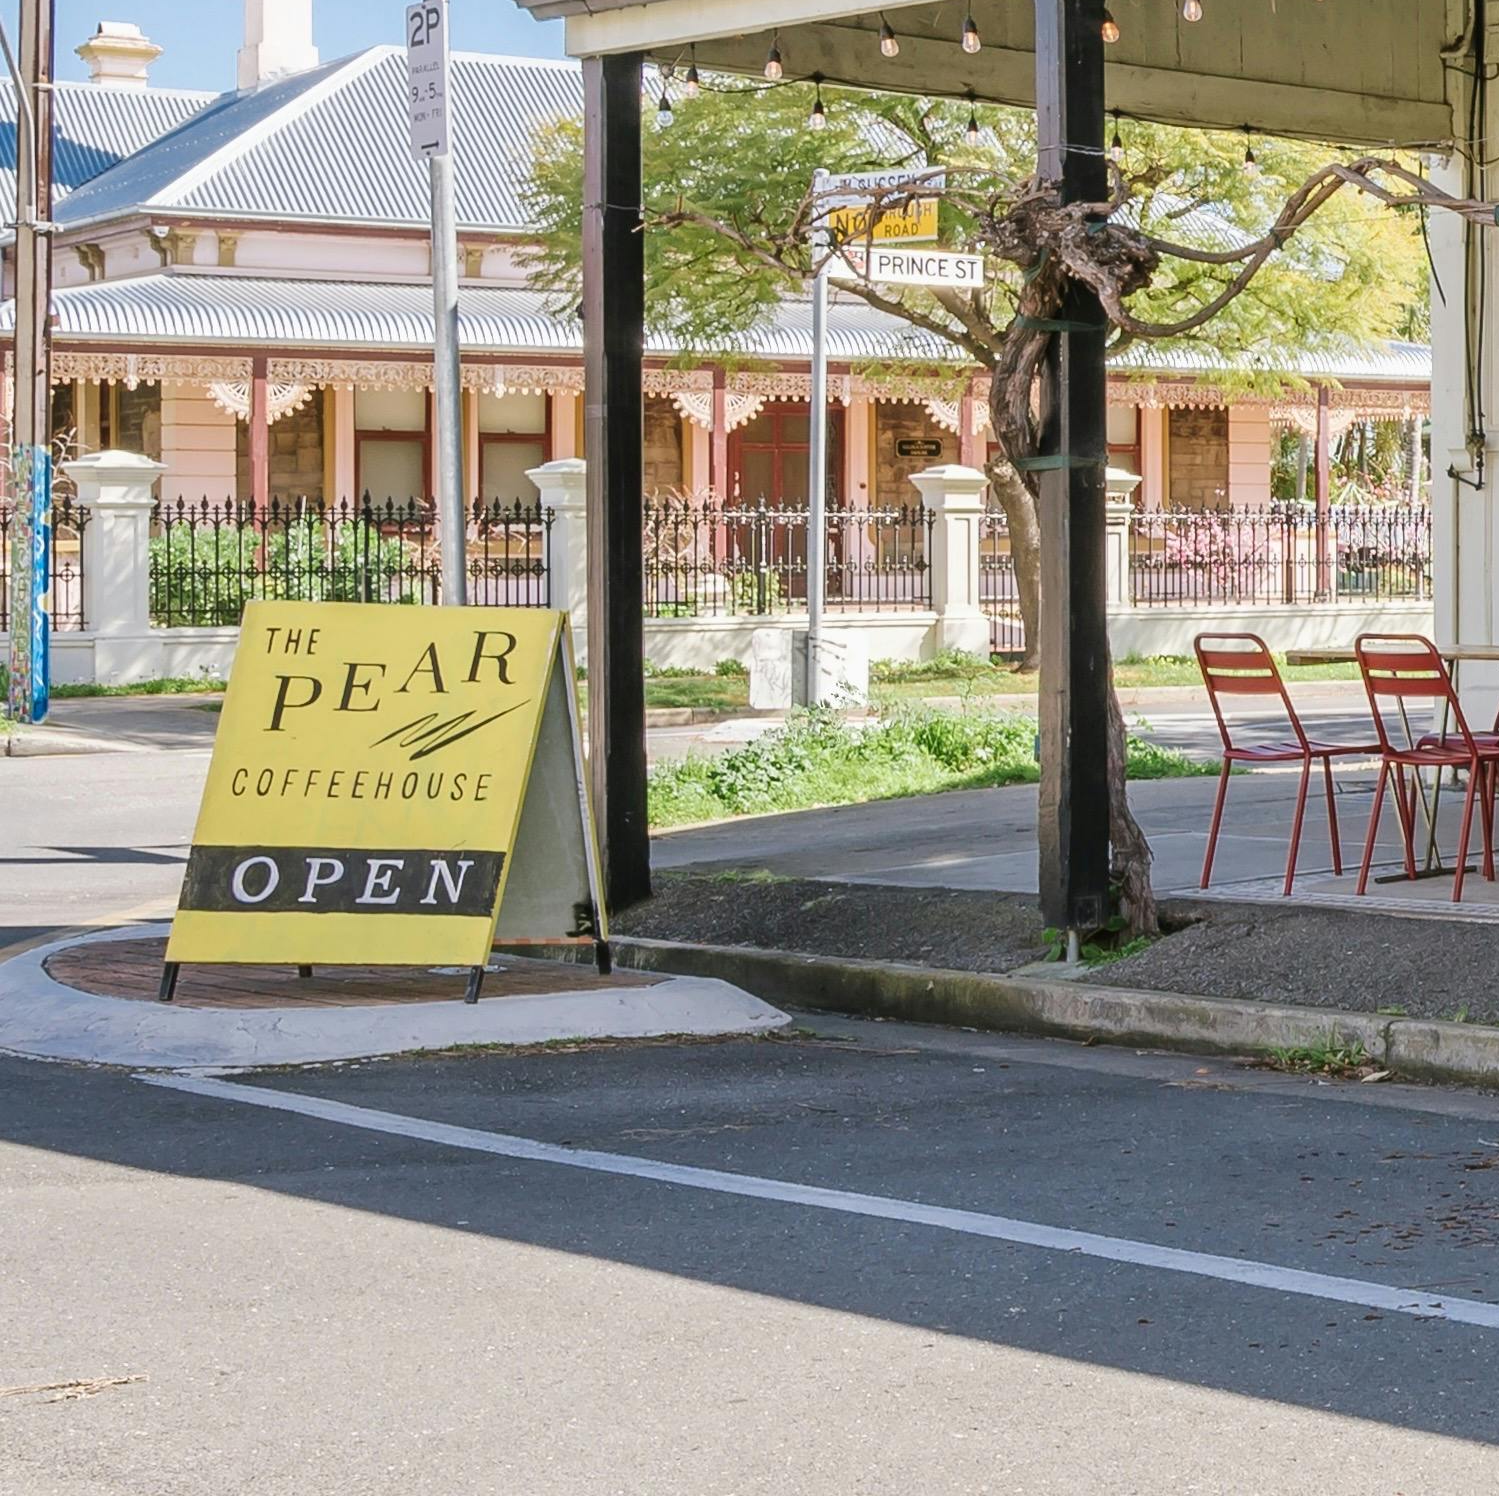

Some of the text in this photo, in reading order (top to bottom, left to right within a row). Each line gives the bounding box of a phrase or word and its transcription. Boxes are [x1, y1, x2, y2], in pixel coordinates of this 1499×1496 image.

[410, 7, 440, 48] 2P
[884, 224, 919, 238] ROAD
[879, 255, 978, 280] PRINCE ST
[265, 627, 321, 656] THE
[262, 630, 518, 732] PEAR
[231, 767, 494, 802] COFFEEHOUSE
[231, 855, 476, 905] OPEN
